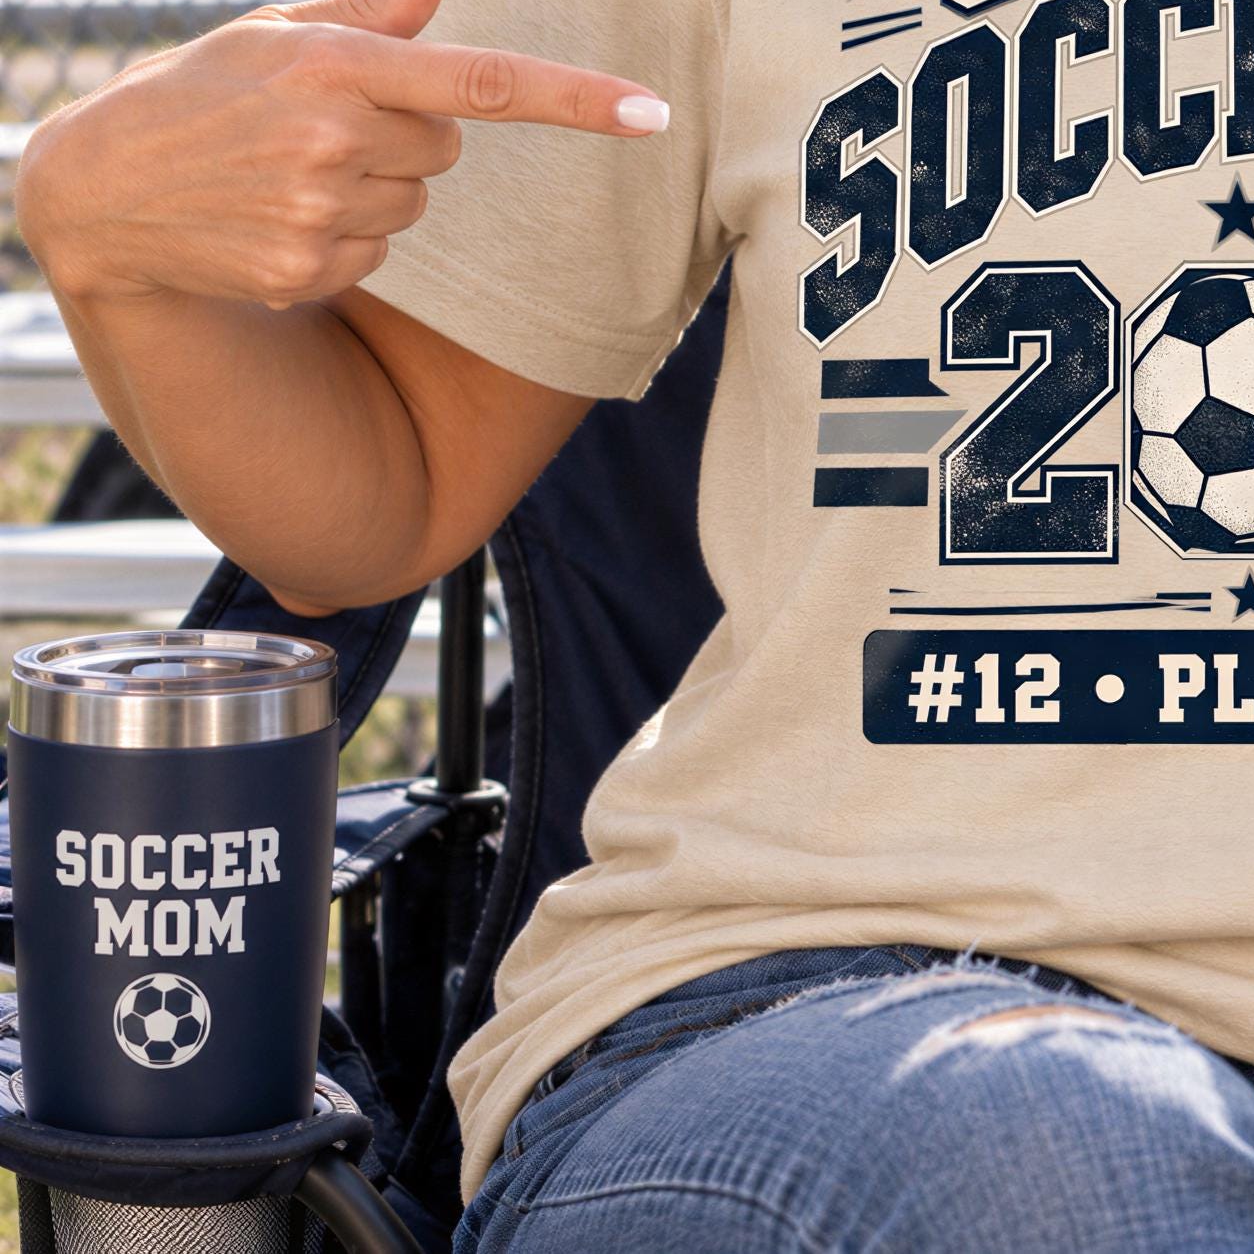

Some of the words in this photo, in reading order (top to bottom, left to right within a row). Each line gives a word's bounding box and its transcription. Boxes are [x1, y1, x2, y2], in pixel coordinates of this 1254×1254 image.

[907, 653, 1062, 723] #12
[55, 826, 281, 891] SOCCER
[93, 895, 246, 957] MOM
